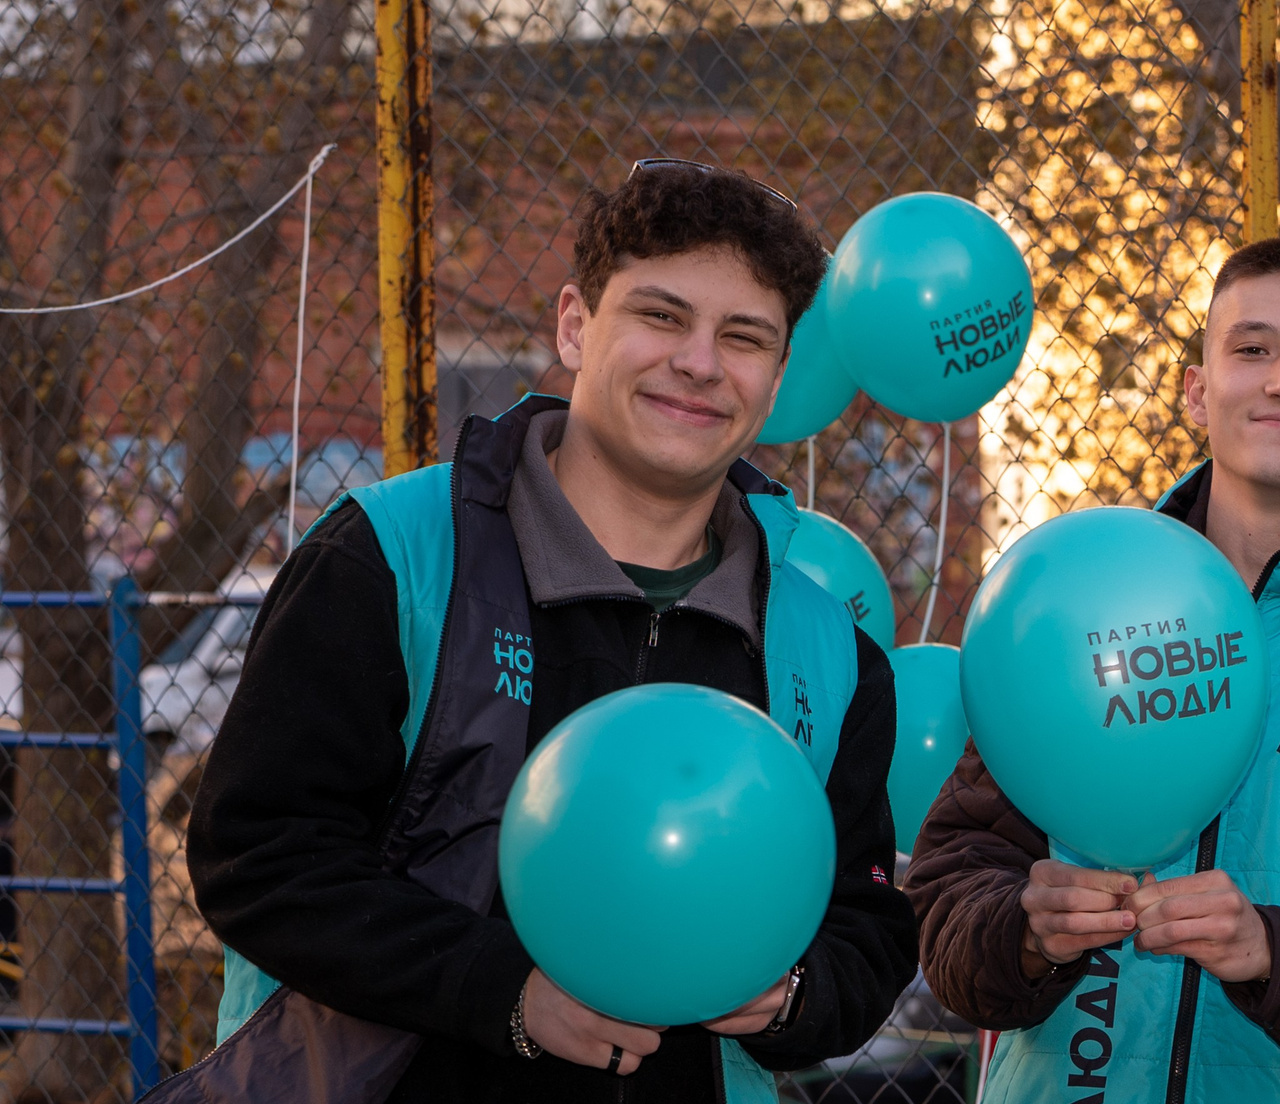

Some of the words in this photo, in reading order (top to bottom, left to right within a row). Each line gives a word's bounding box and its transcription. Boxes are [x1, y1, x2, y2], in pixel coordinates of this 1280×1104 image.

[930, 299, 993, 331] ПАРТИЯ
[934, 290, 1027, 355] НОВЫЕ
[943, 326, 1020, 378] ЛЮДИ
[494, 627, 532, 647] ПАРТ
[1087, 617, 1187, 646] ПАРТИЯ
[1092, 630, 1248, 687] НОВЫЕ
[494, 671, 533, 706] ЛЮ
[1102, 676, 1232, 728] ЛЮДИ
